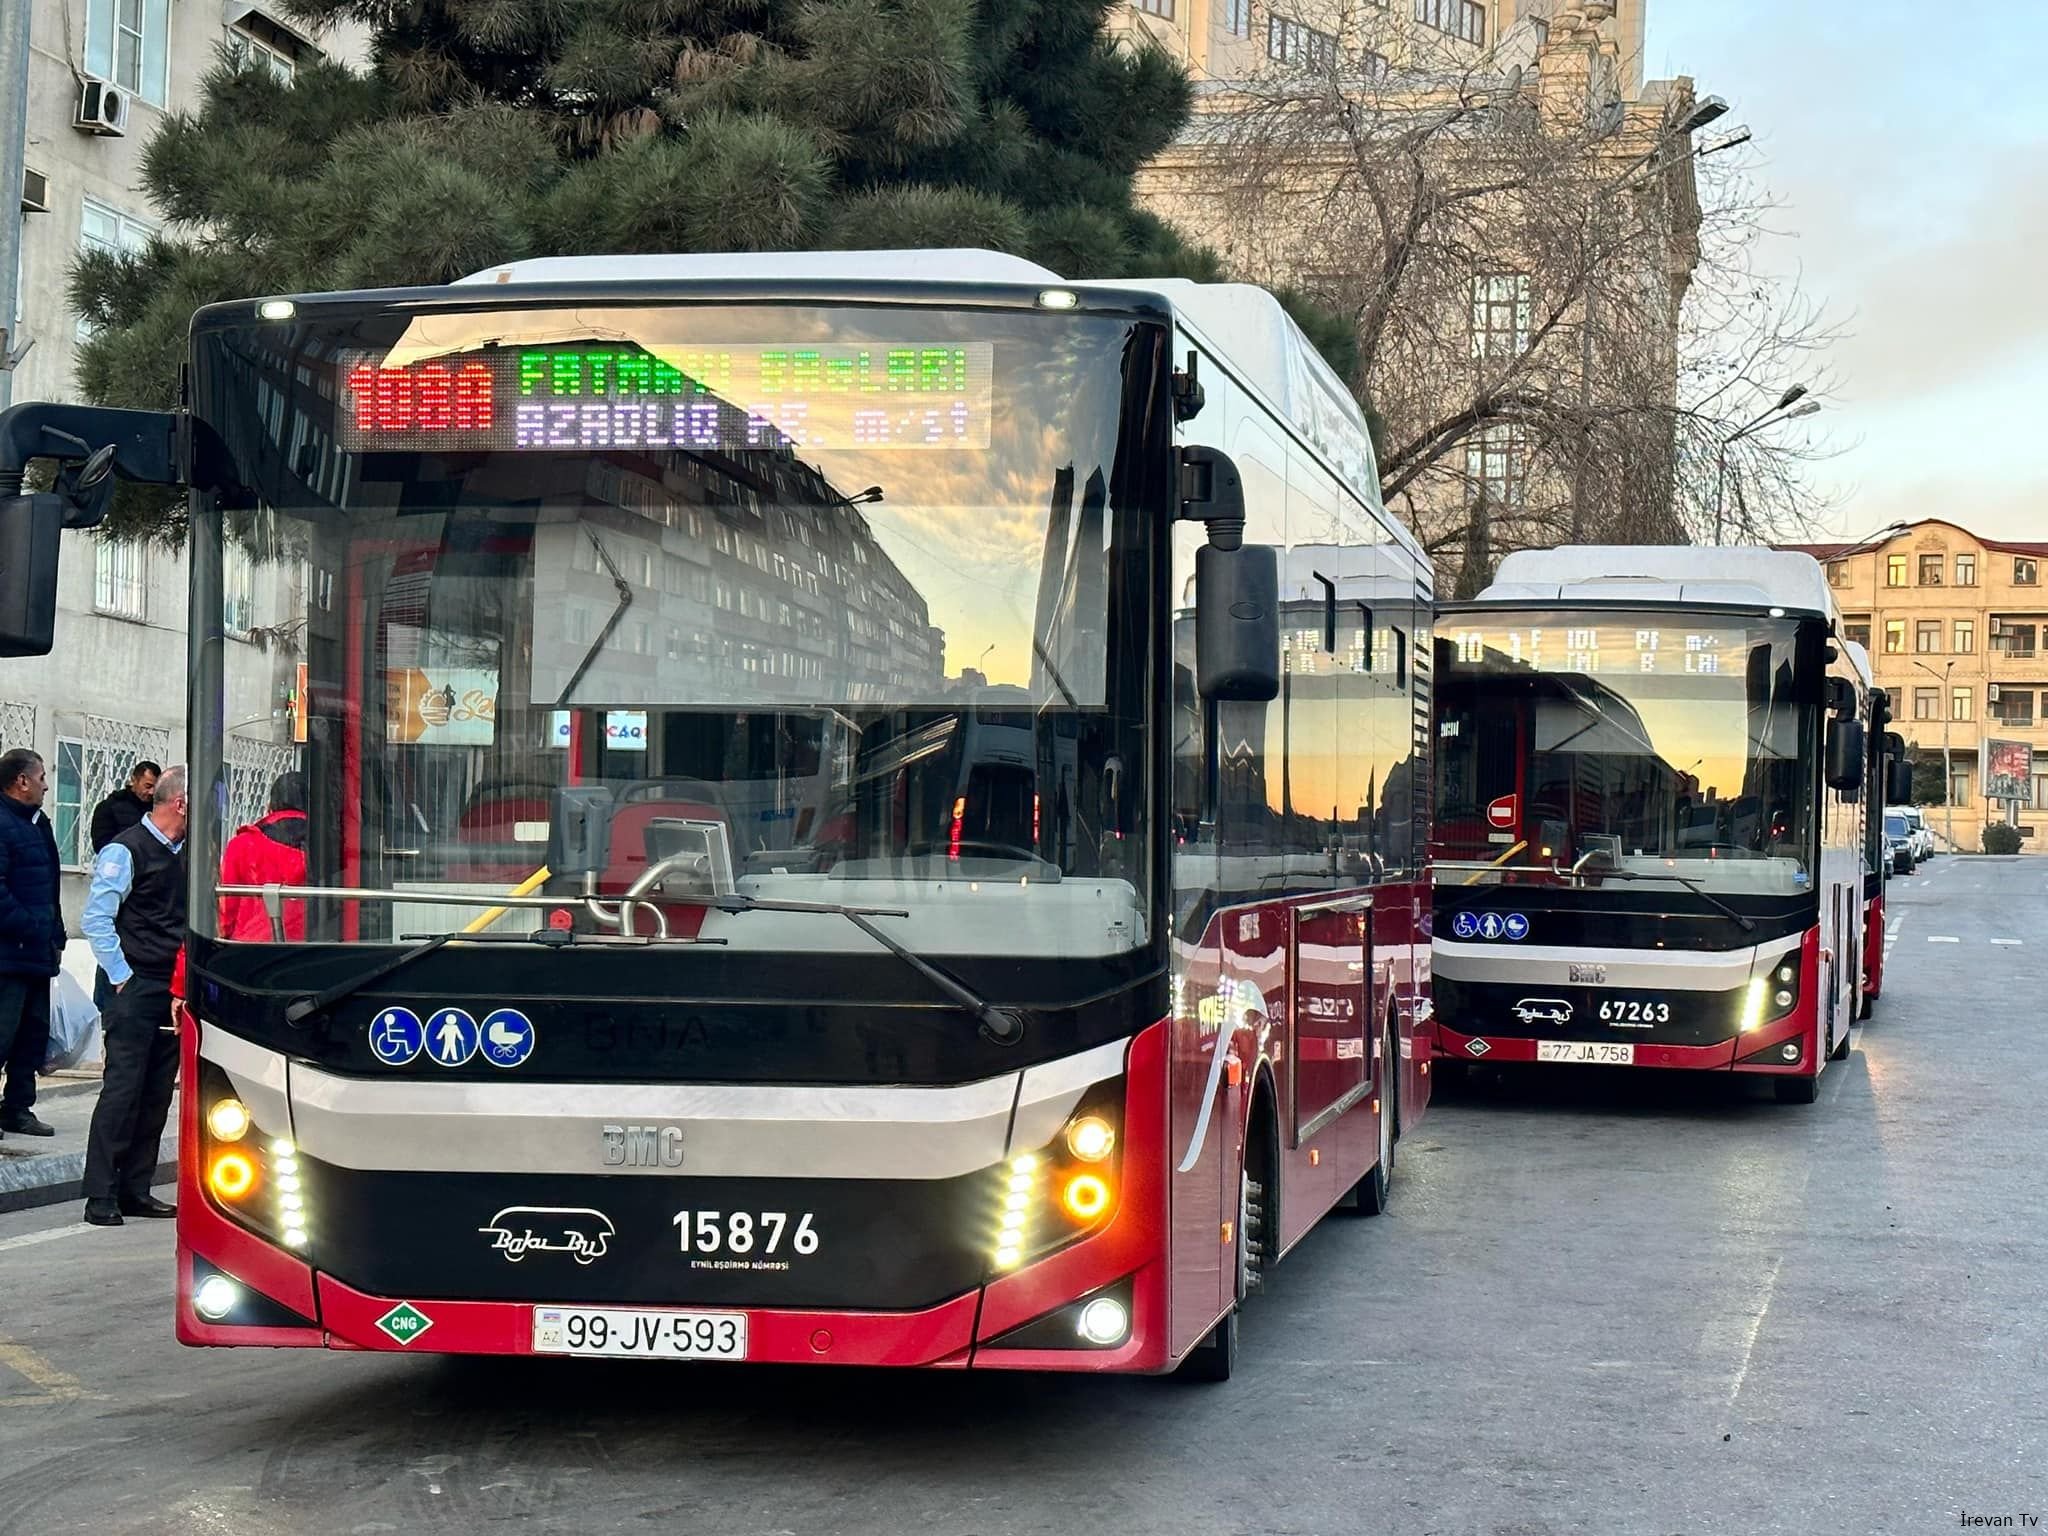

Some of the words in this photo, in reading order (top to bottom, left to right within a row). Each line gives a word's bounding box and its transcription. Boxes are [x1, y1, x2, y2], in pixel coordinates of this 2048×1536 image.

[516, 404, 718, 445] AZADLIQ
[1568, 963, 1607, 984] BMC
[1599, 1000, 1670, 1023] 67263
[602, 1125, 684, 1168] BMC
[672, 1210, 819, 1255] 15876
[391, 1316, 417, 1330] CNG
[567, 1314, 737, 1353] 99-JV-593
